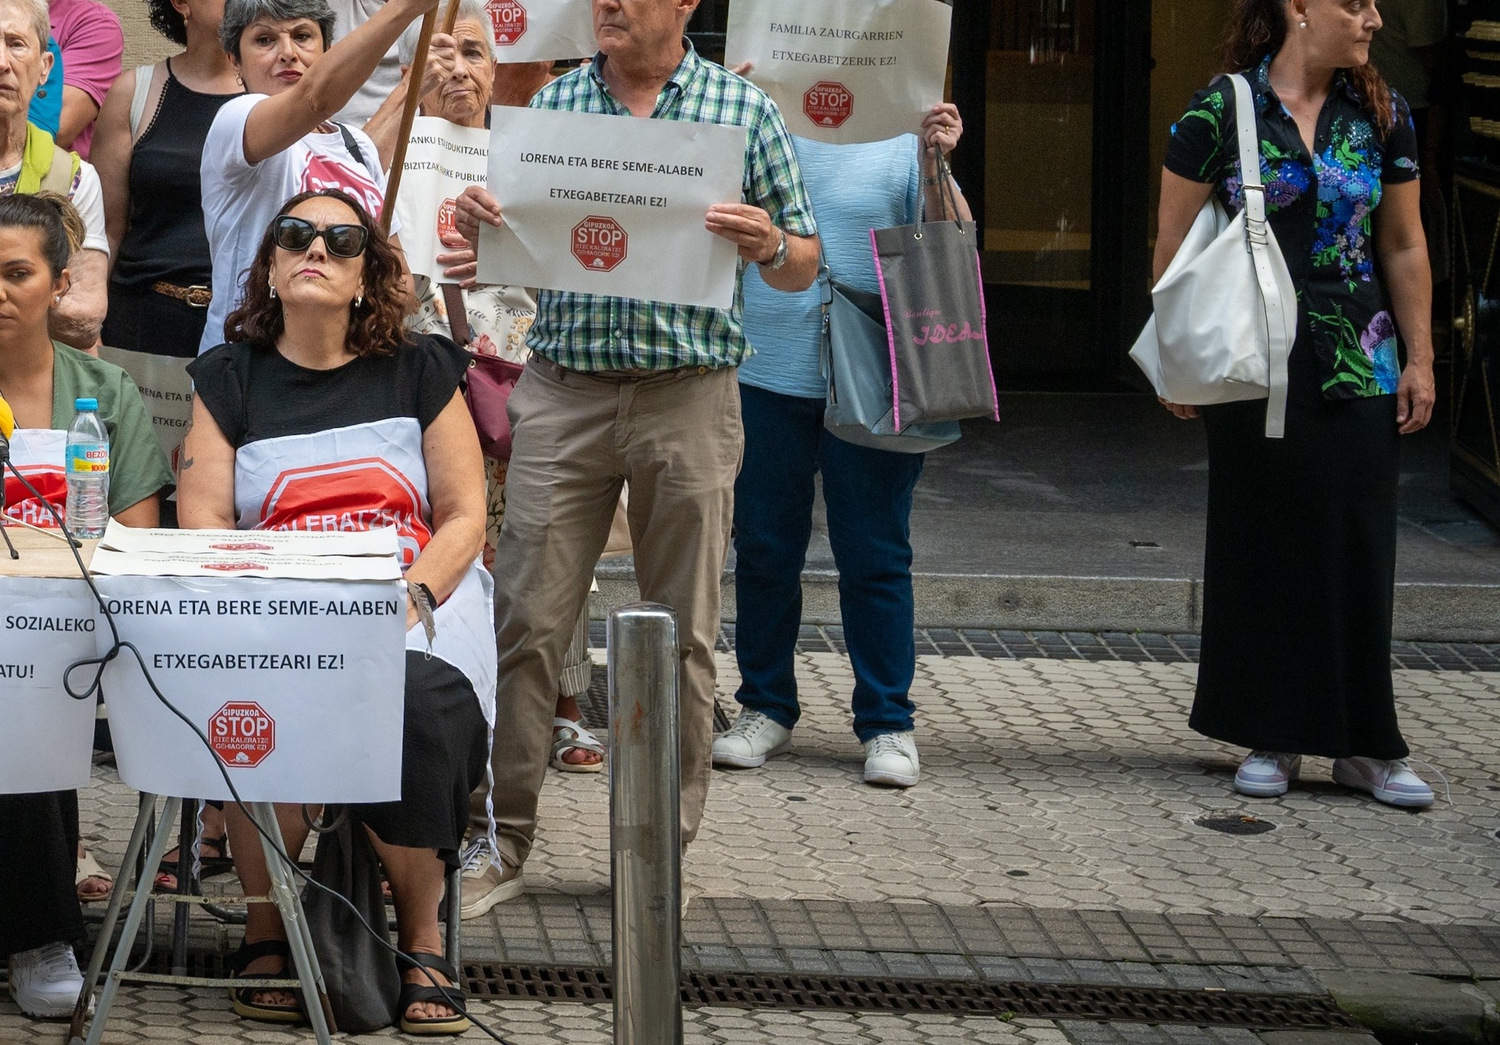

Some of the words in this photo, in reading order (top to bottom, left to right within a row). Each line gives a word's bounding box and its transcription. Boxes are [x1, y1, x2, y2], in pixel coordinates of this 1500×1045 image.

[484, 7, 522, 23] STOP
[770, 22, 817, 36] FAMILIA
[819, 27, 904, 41] ZAURGARRIEN
[772, 50, 877, 66] ETXEGABETZERIK
[879, 56, 897, 66] EZ!
[809, 91, 849, 107] STOP
[408, 136, 436, 144] ANKU
[520, 153, 565, 166] LORENA
[568, 156, 588, 167] ETA
[591, 158, 619, 170] BERE
[622, 160, 704, 177] SEME-ALABEN
[455, 171, 488, 183] PUBLIK
[550, 187, 647, 206] ETXEGABETZEARI
[649, 196, 667, 208] EZ!
[577, 227, 623, 246] STOP
[138, 386, 163, 399] RENA
[165, 392, 183, 402] ETA
[99, 599, 173, 616] LORENA
[179, 600, 211, 615] ETA
[217, 600, 262, 615] BERE
[268, 599, 398, 616] SEME-ALABEN
[5, 614, 96, 632] SOZIALEKO
[153, 653, 311, 670] ETXEGABETZEARI
[317, 654, 345, 670] EZ!
[222, 708, 260, 717] GIPUZKOA
[215, 715, 269, 737] STOP
